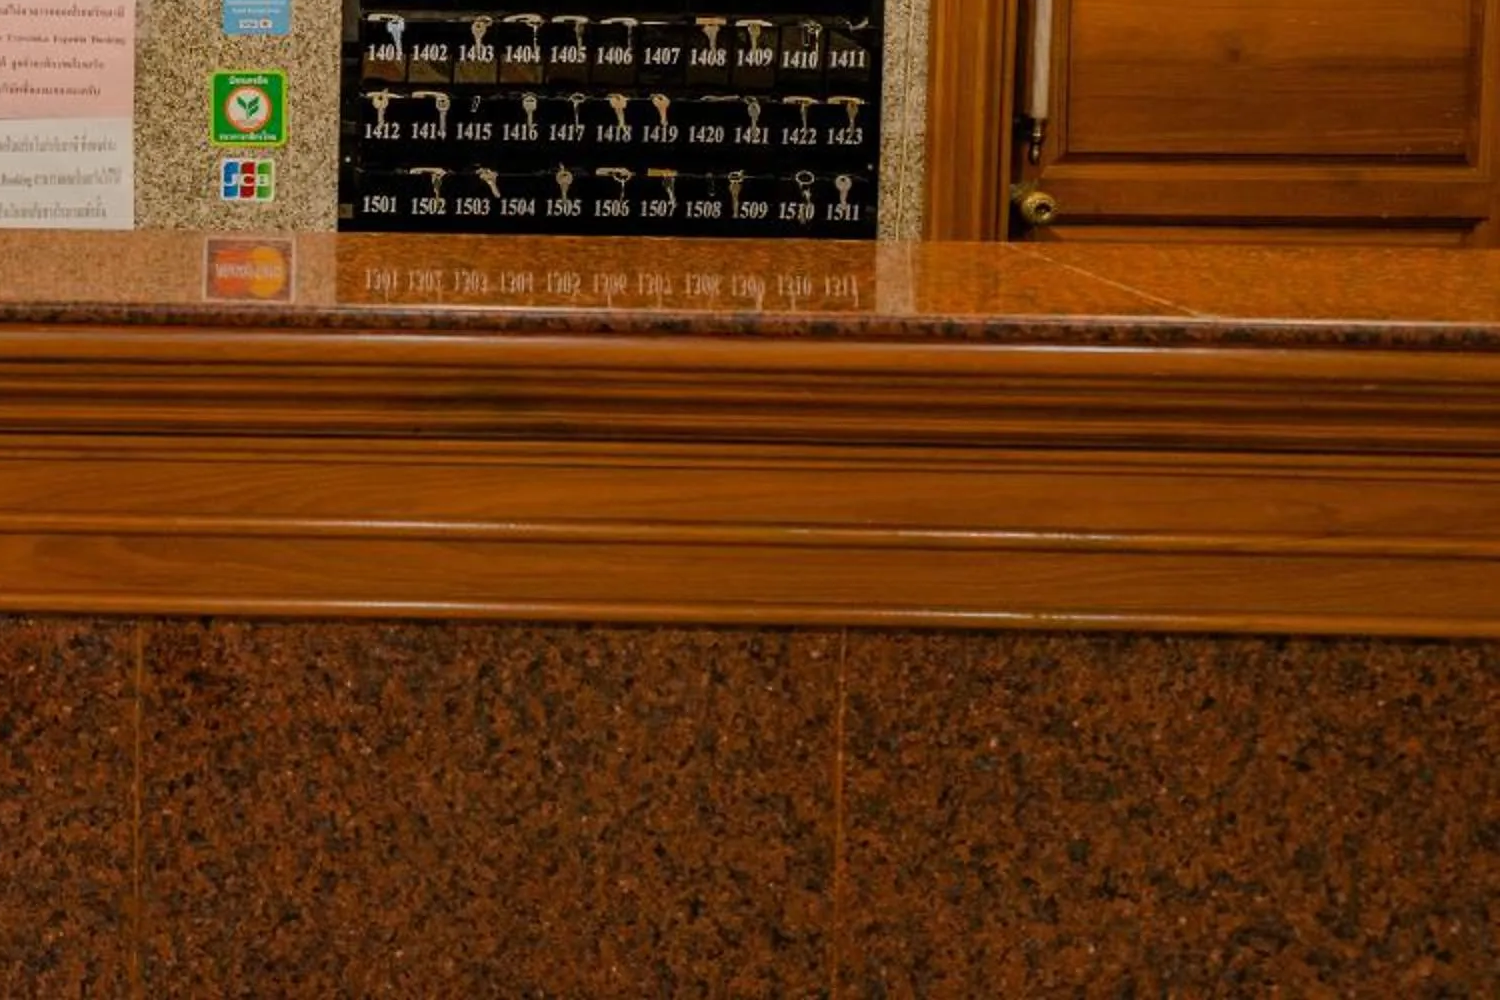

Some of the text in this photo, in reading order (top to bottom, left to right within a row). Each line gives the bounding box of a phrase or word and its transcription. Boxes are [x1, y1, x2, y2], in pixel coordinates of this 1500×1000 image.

[368, 45, 865, 68] 1401 1402 1403 1404 1405 1406 1407 1408 1409 1410 1411
[364, 123, 400, 140] 1412
[411, 123, 447, 140] 1414
[456, 123, 492, 140] 1415
[503, 124, 538, 141] 1416
[550, 124, 585, 141] 1417
[596, 125, 632, 142] 1418
[642, 126, 679, 143] 1419
[689, 126, 724, 143] 1420
[781, 128, 817, 145] 1422
[827, 128, 863, 145] 1423
[363, 196, 397, 213] 1501
[411, 198, 447, 215] 1502
[456, 198, 490, 215] 1503
[500, 199, 535, 216] 1504
[546, 199, 581, 216] 1505
[594, 200, 629, 217] 1506
[640, 200, 677, 217] 1507
[685, 201, 722, 218] 1508
[733, 201, 769, 218] 509
[826, 204, 860, 221] 1511
